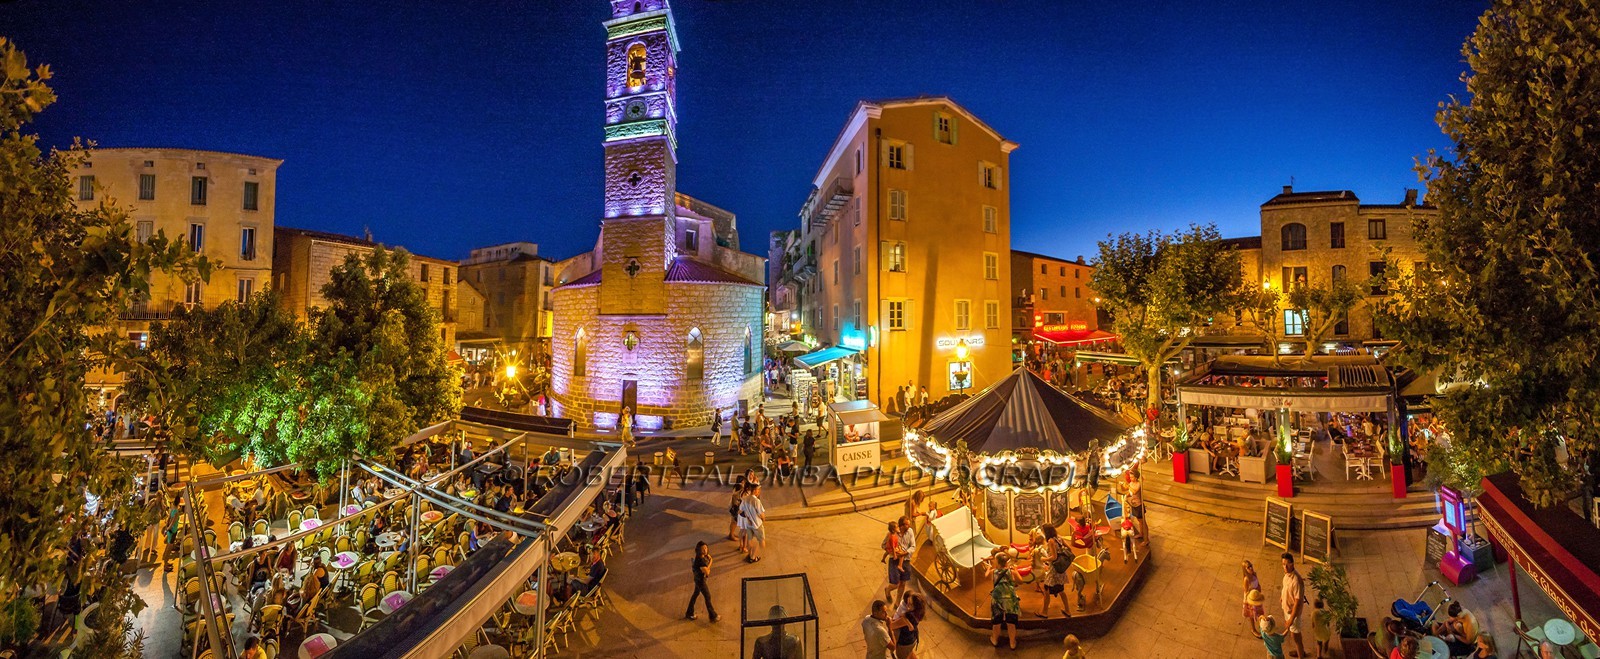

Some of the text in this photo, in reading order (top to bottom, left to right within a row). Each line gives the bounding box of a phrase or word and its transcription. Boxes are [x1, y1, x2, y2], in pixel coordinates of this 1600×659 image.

[938, 338, 984, 346] SOUVNRS
[842, 450, 872, 462] CAISSE
[1527, 562, 1597, 642] Le Glacier de
